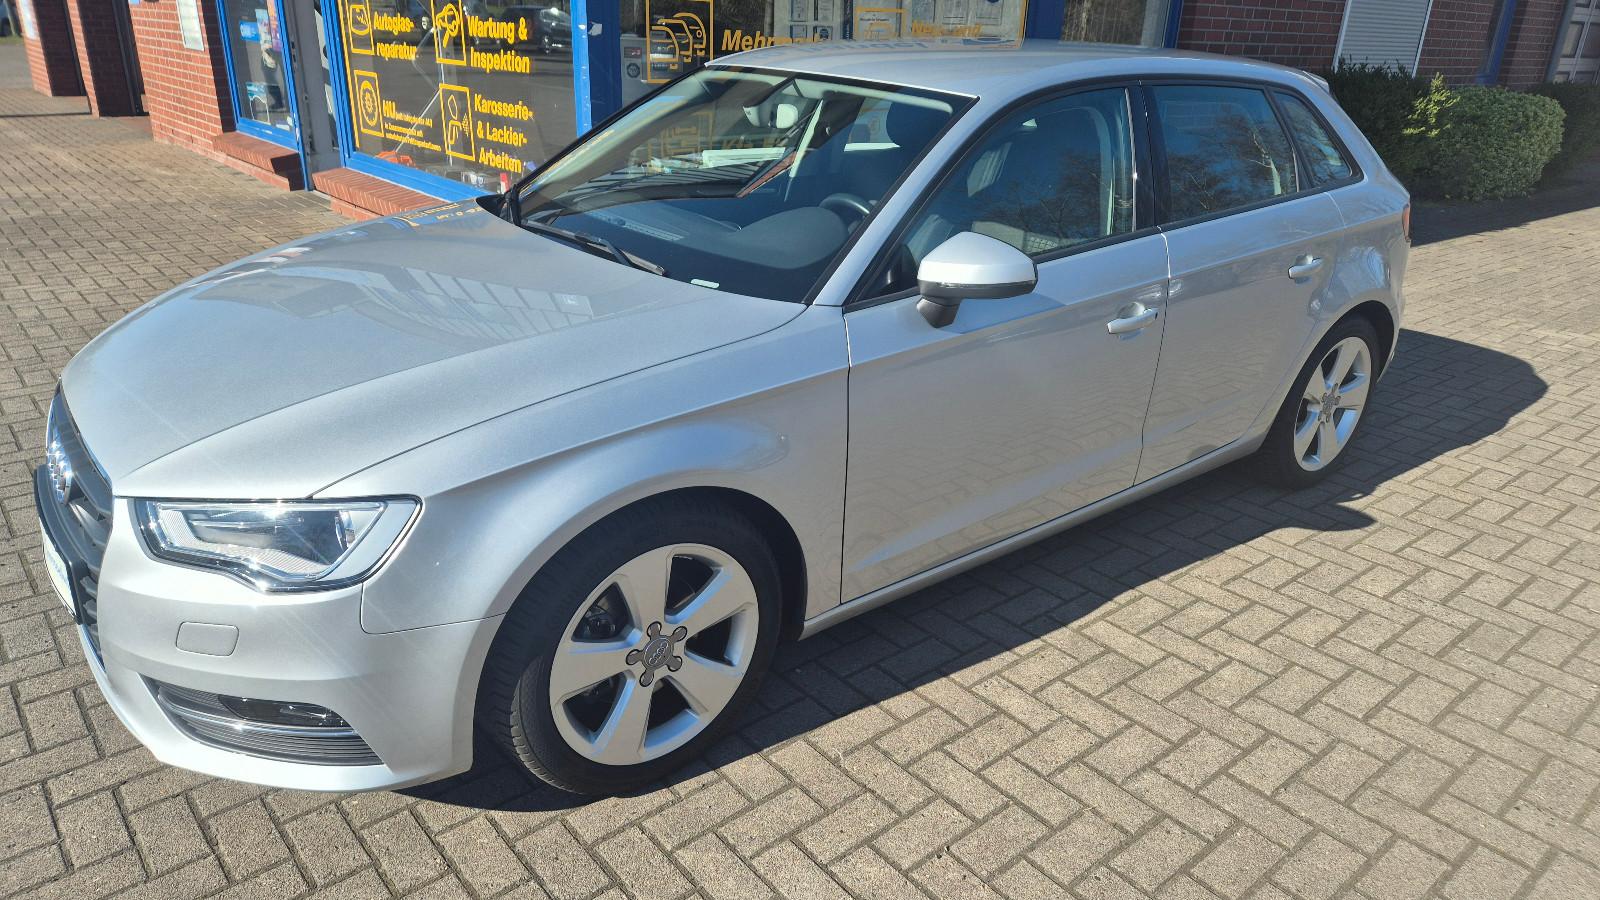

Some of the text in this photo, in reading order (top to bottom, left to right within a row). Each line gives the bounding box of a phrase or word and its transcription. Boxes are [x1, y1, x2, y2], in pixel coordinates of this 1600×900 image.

[374, 11, 415, 36] Autoglas-
[467, 15, 529, 45] Wartung &
[376, 42, 418, 61] reparatur
[470, 47, 531, 74] Inspektion
[382, 99, 396, 119] HU
[474, 93, 534, 122] Karosserie-
[477, 120, 528, 148] & Lackier-
[478, 146, 523, 174] Arbeiten
